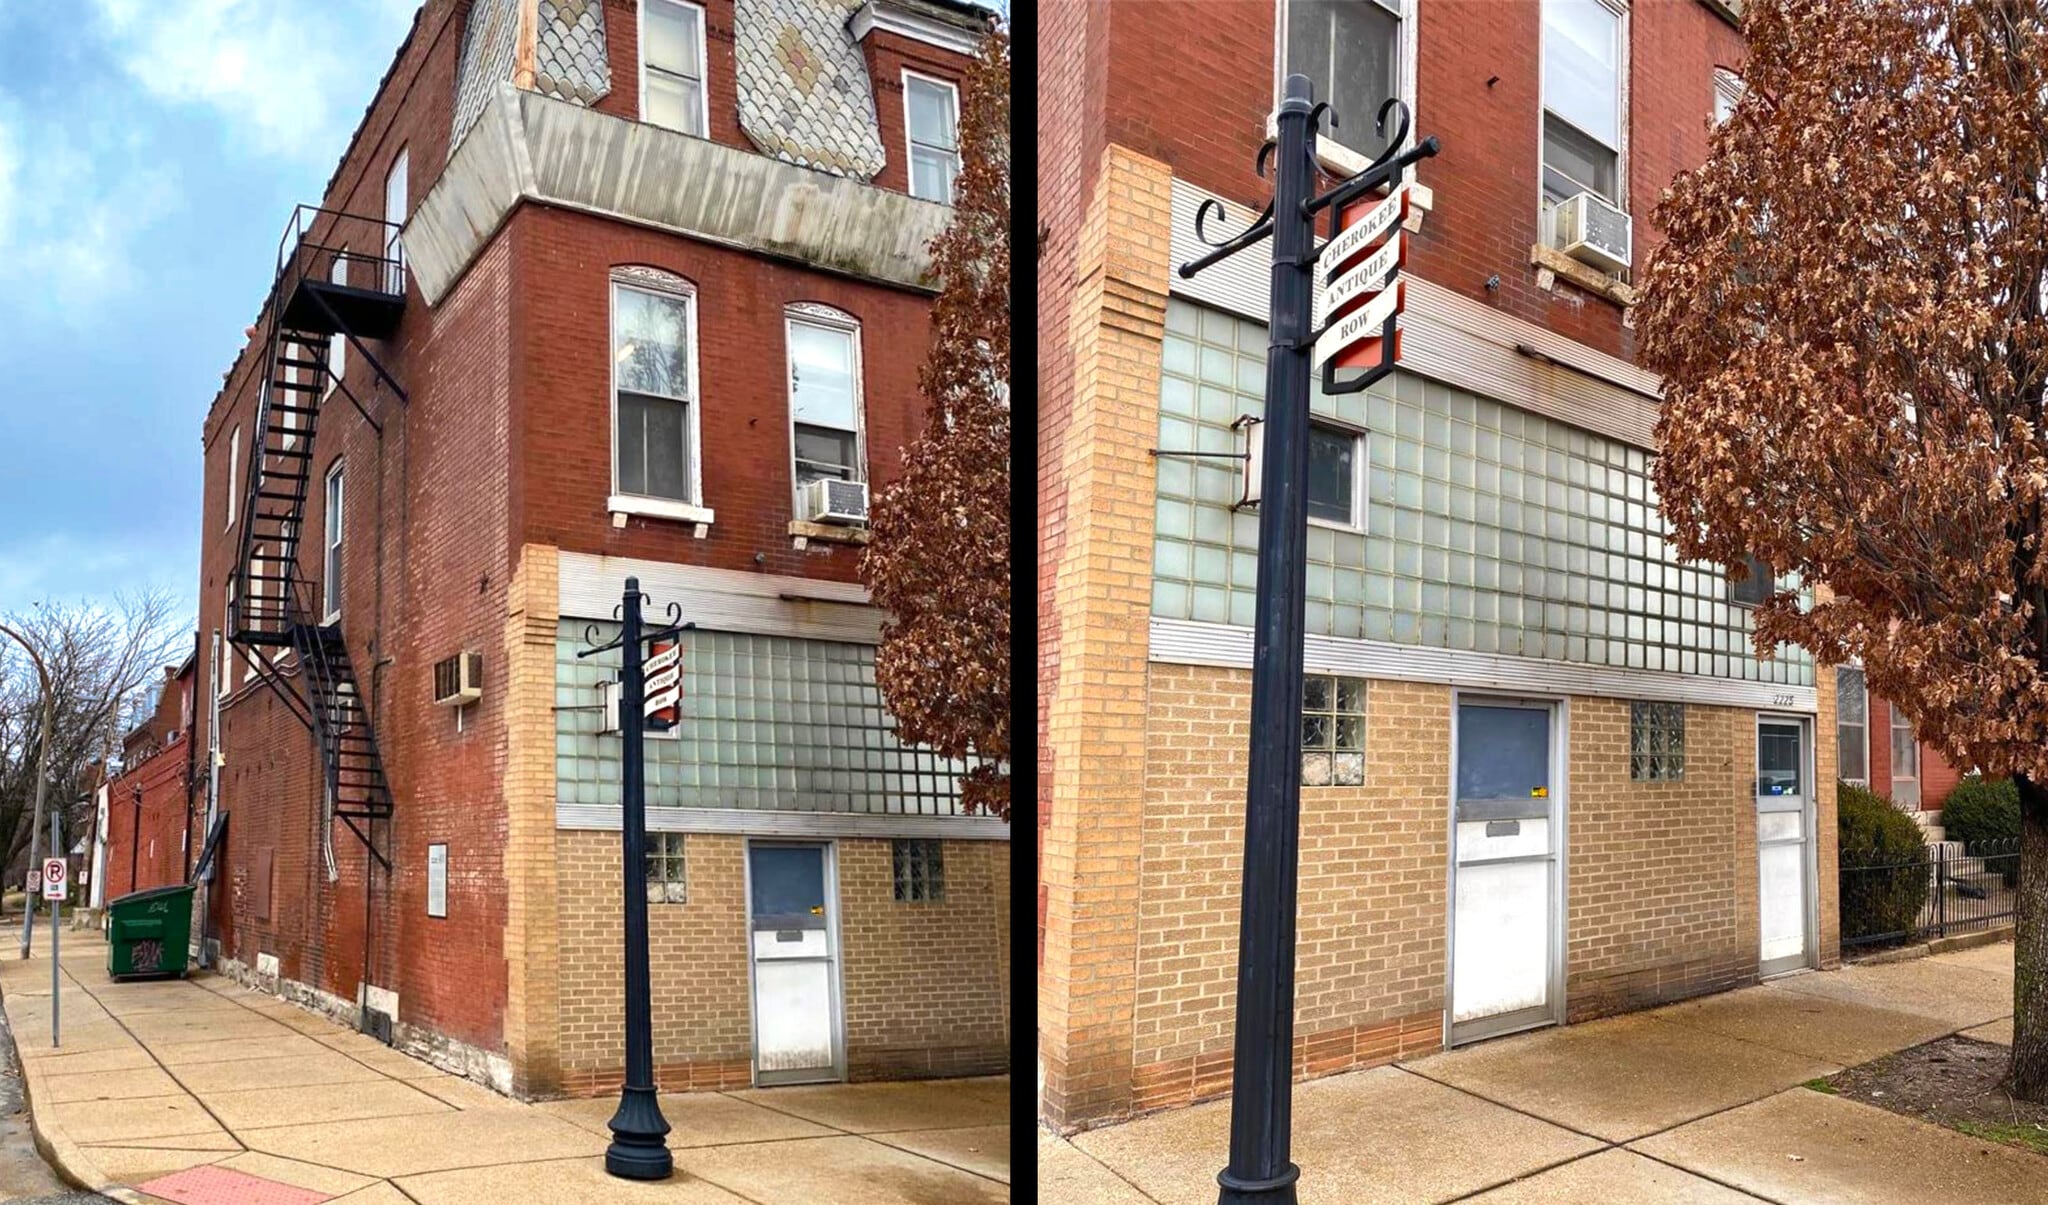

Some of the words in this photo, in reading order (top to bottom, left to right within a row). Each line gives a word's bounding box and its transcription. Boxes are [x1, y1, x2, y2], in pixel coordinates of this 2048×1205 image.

[1323, 196, 1397, 269] CHEROKEE
[1328, 251, 1388, 308] ANTIQUE
[1340, 310, 1370, 339] ROW
